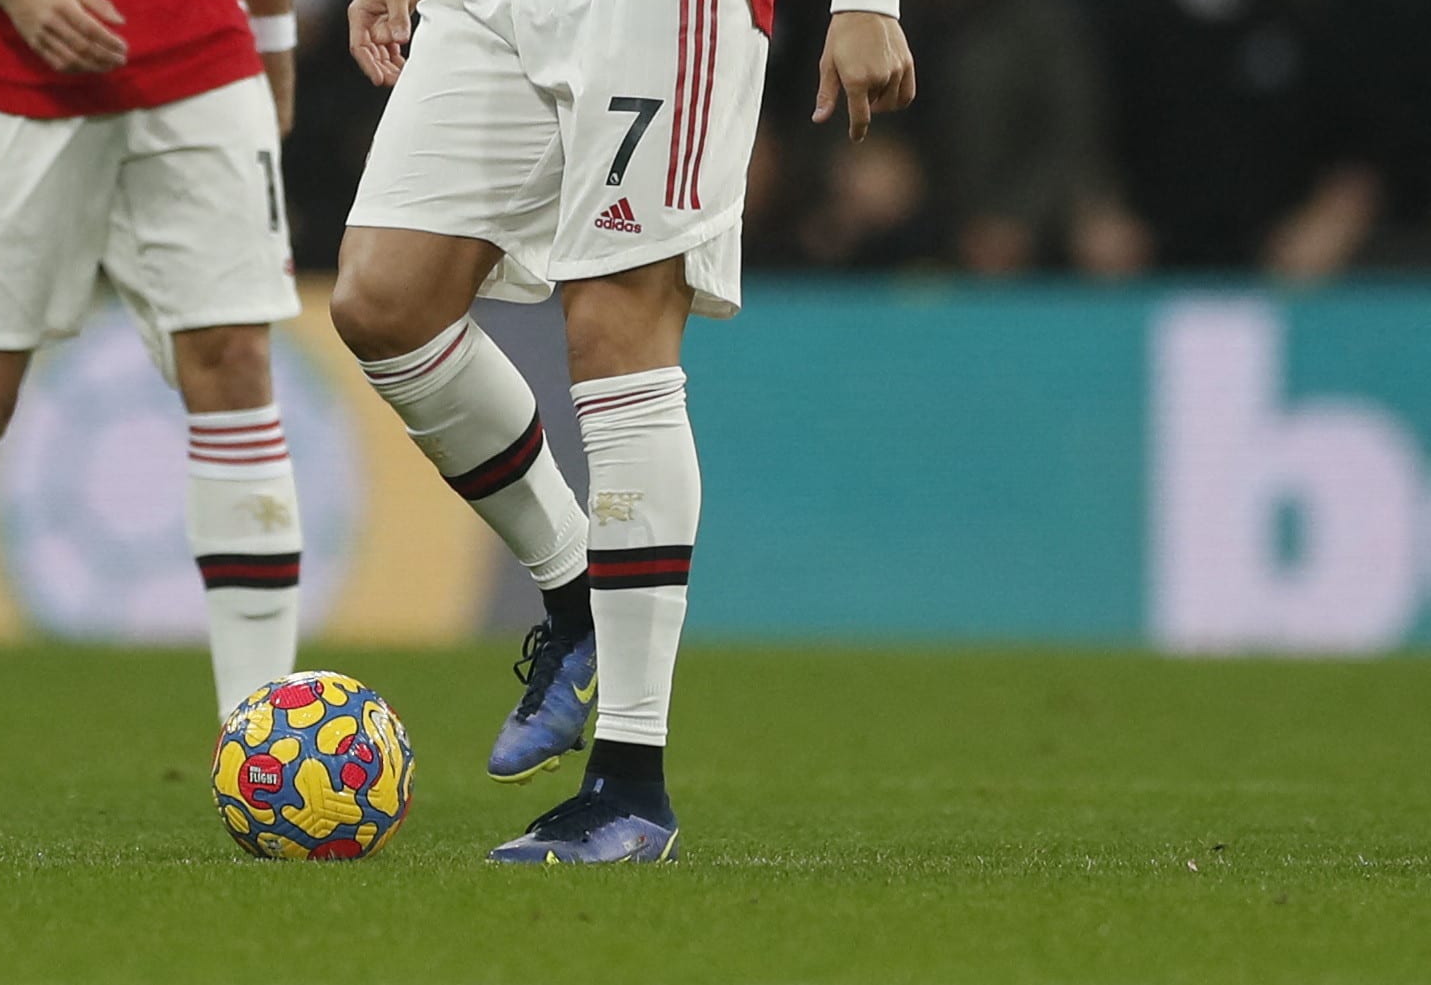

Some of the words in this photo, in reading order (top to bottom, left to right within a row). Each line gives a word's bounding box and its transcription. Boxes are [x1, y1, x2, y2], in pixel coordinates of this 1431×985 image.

[606, 96, 664, 186] 7
[594, 216, 642, 234] adidas
[1148, 296, 1431, 658] b
[249, 772, 277, 785] FLIGHT
